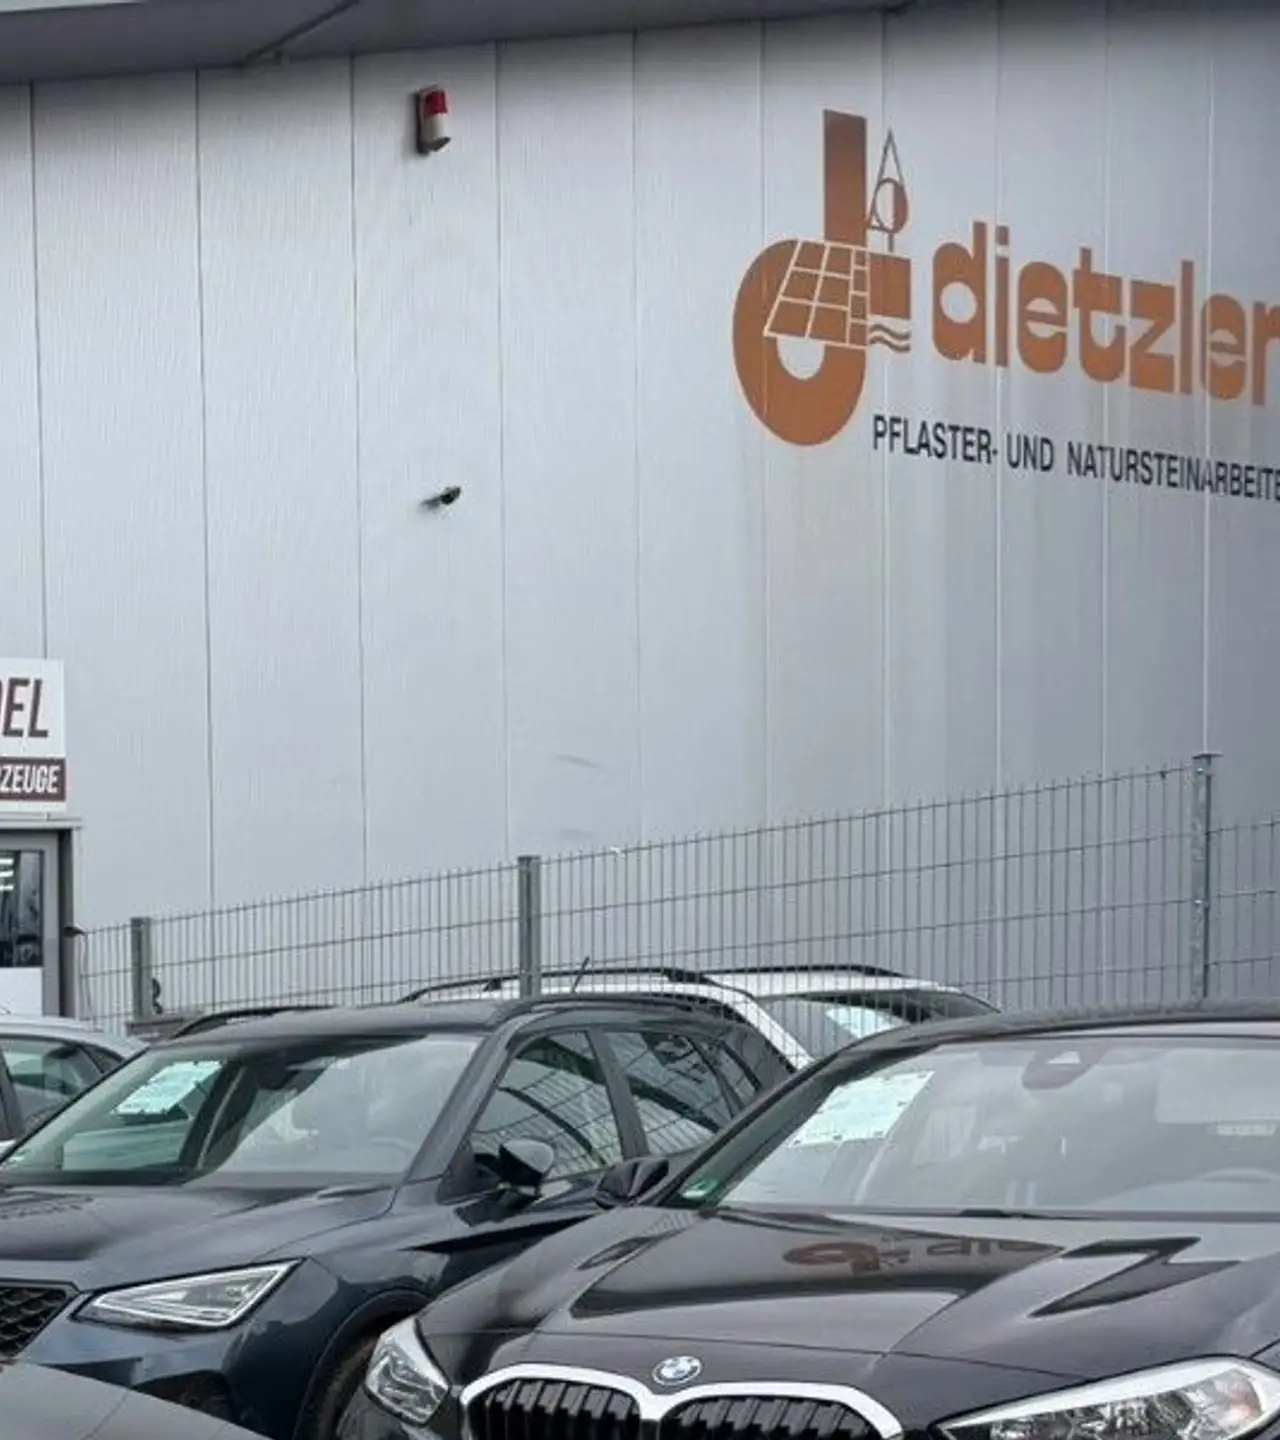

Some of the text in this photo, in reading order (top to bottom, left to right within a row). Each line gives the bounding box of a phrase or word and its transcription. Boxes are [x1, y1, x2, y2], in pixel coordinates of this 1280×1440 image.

[932, 221, 1279, 406] dietzler
[873, 414, 999, 464] PFLASTER-
[1006, 437, 1055, 473] UND
